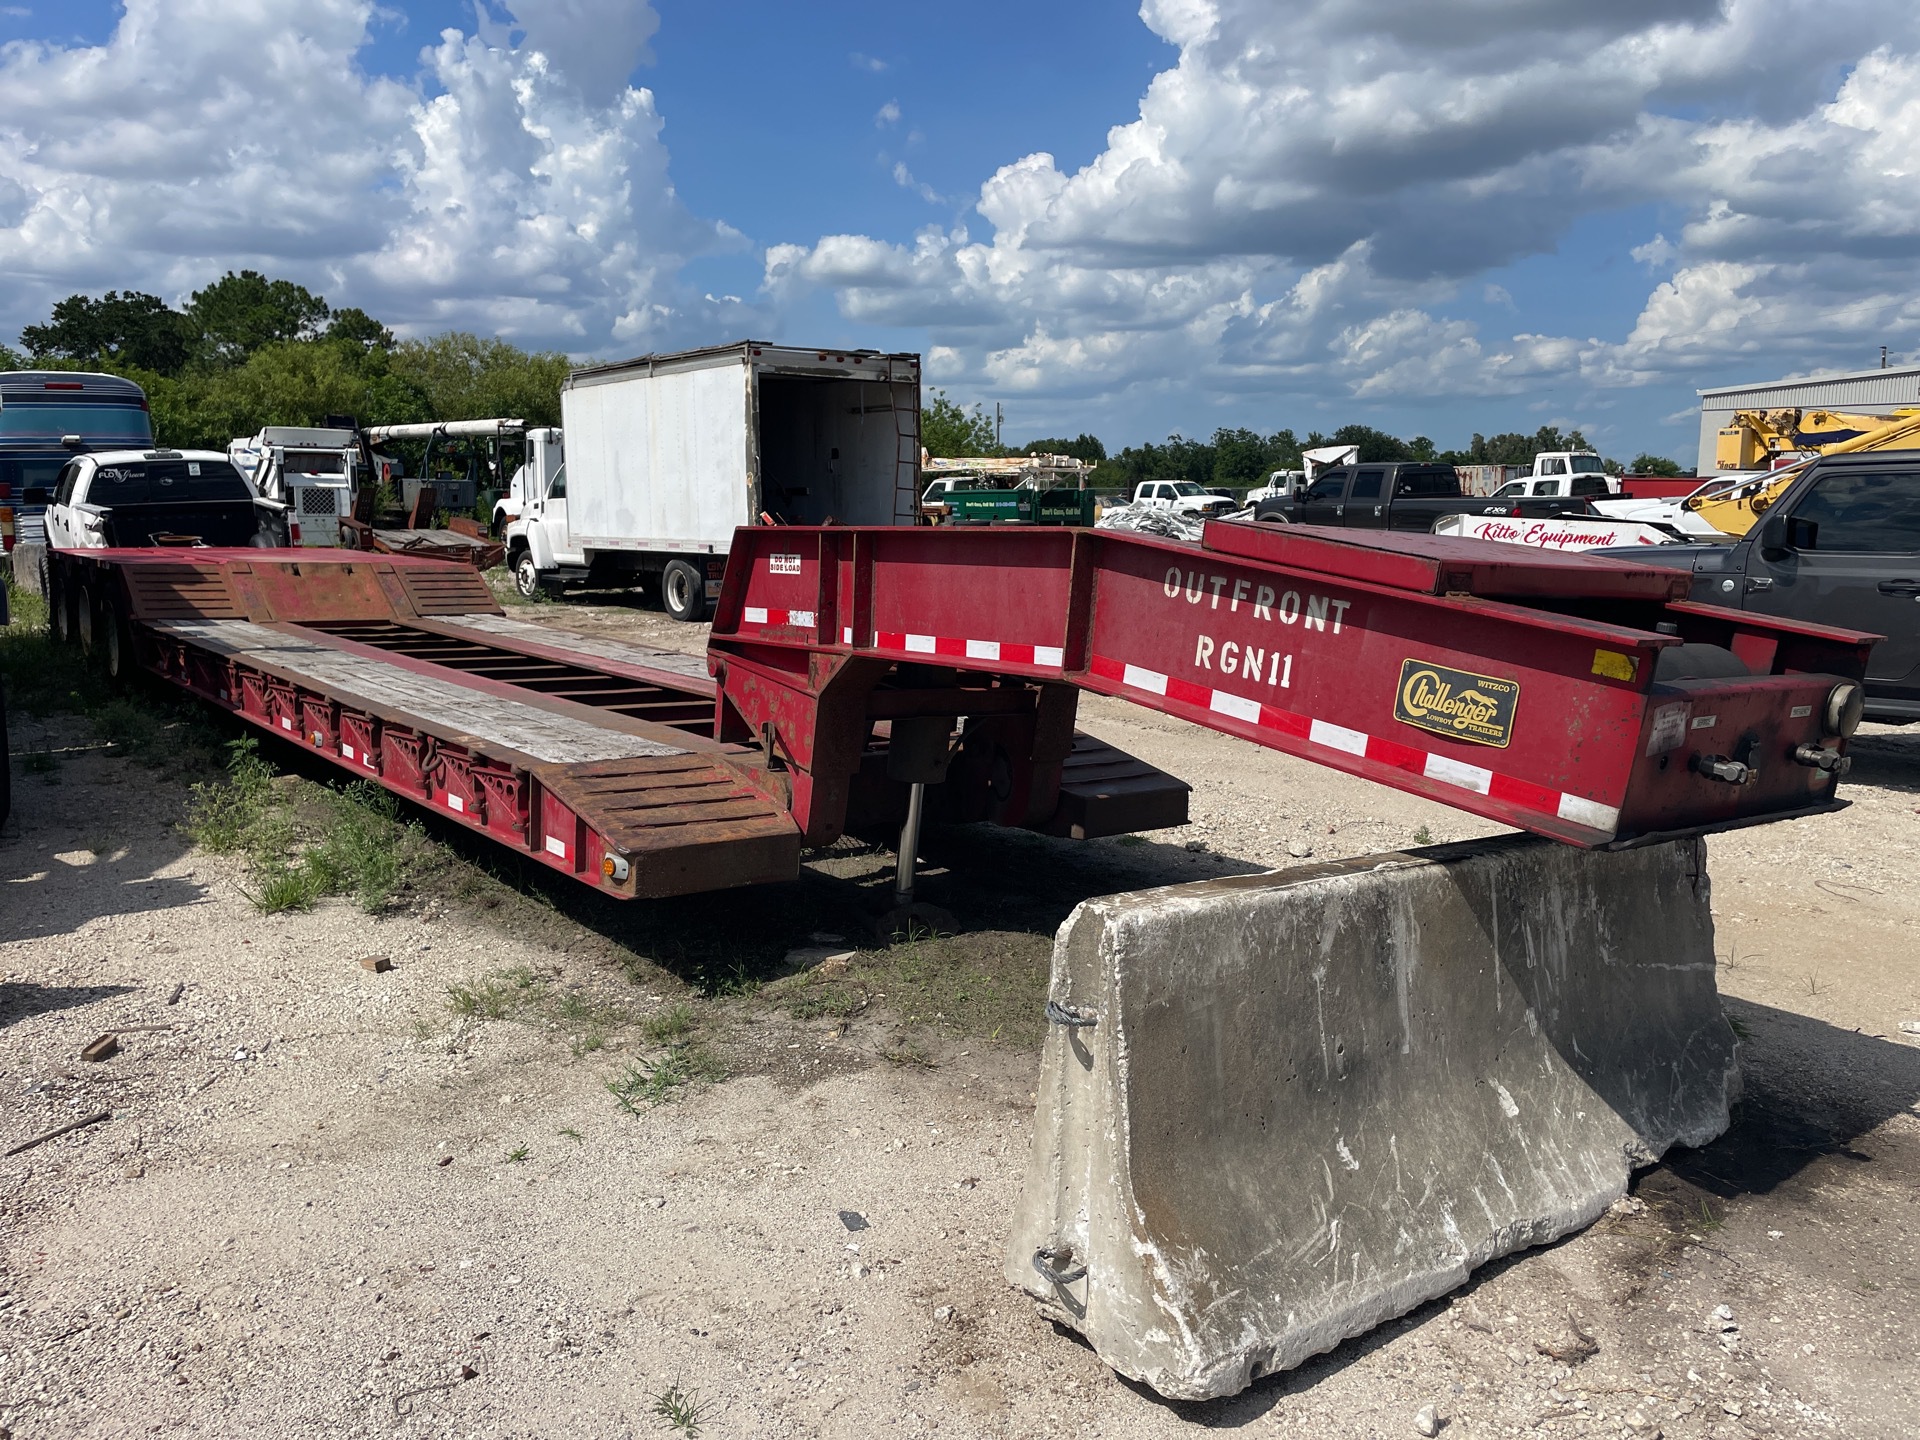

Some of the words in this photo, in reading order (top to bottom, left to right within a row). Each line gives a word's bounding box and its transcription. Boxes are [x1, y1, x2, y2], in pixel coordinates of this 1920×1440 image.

[1041, 508, 1053, 516] Don't
[1474, 522, 1521, 542] Kitto
[1523, 523, 1618, 549] Equipment
[706, 561, 726, 571] GM
[784, 556, 797, 564] NOT
[784, 564, 801, 572] LOAD
[1164, 567, 1352, 635] OUTFRONT
[1195, 634, 1293, 689] RGN11
[1477, 680, 1510, 693] WITZCO
[1403, 670, 1504, 729] Challenger
[1426, 713, 1453, 726] LOWBOY
[1468, 724, 1503, 738] TRAILERS
